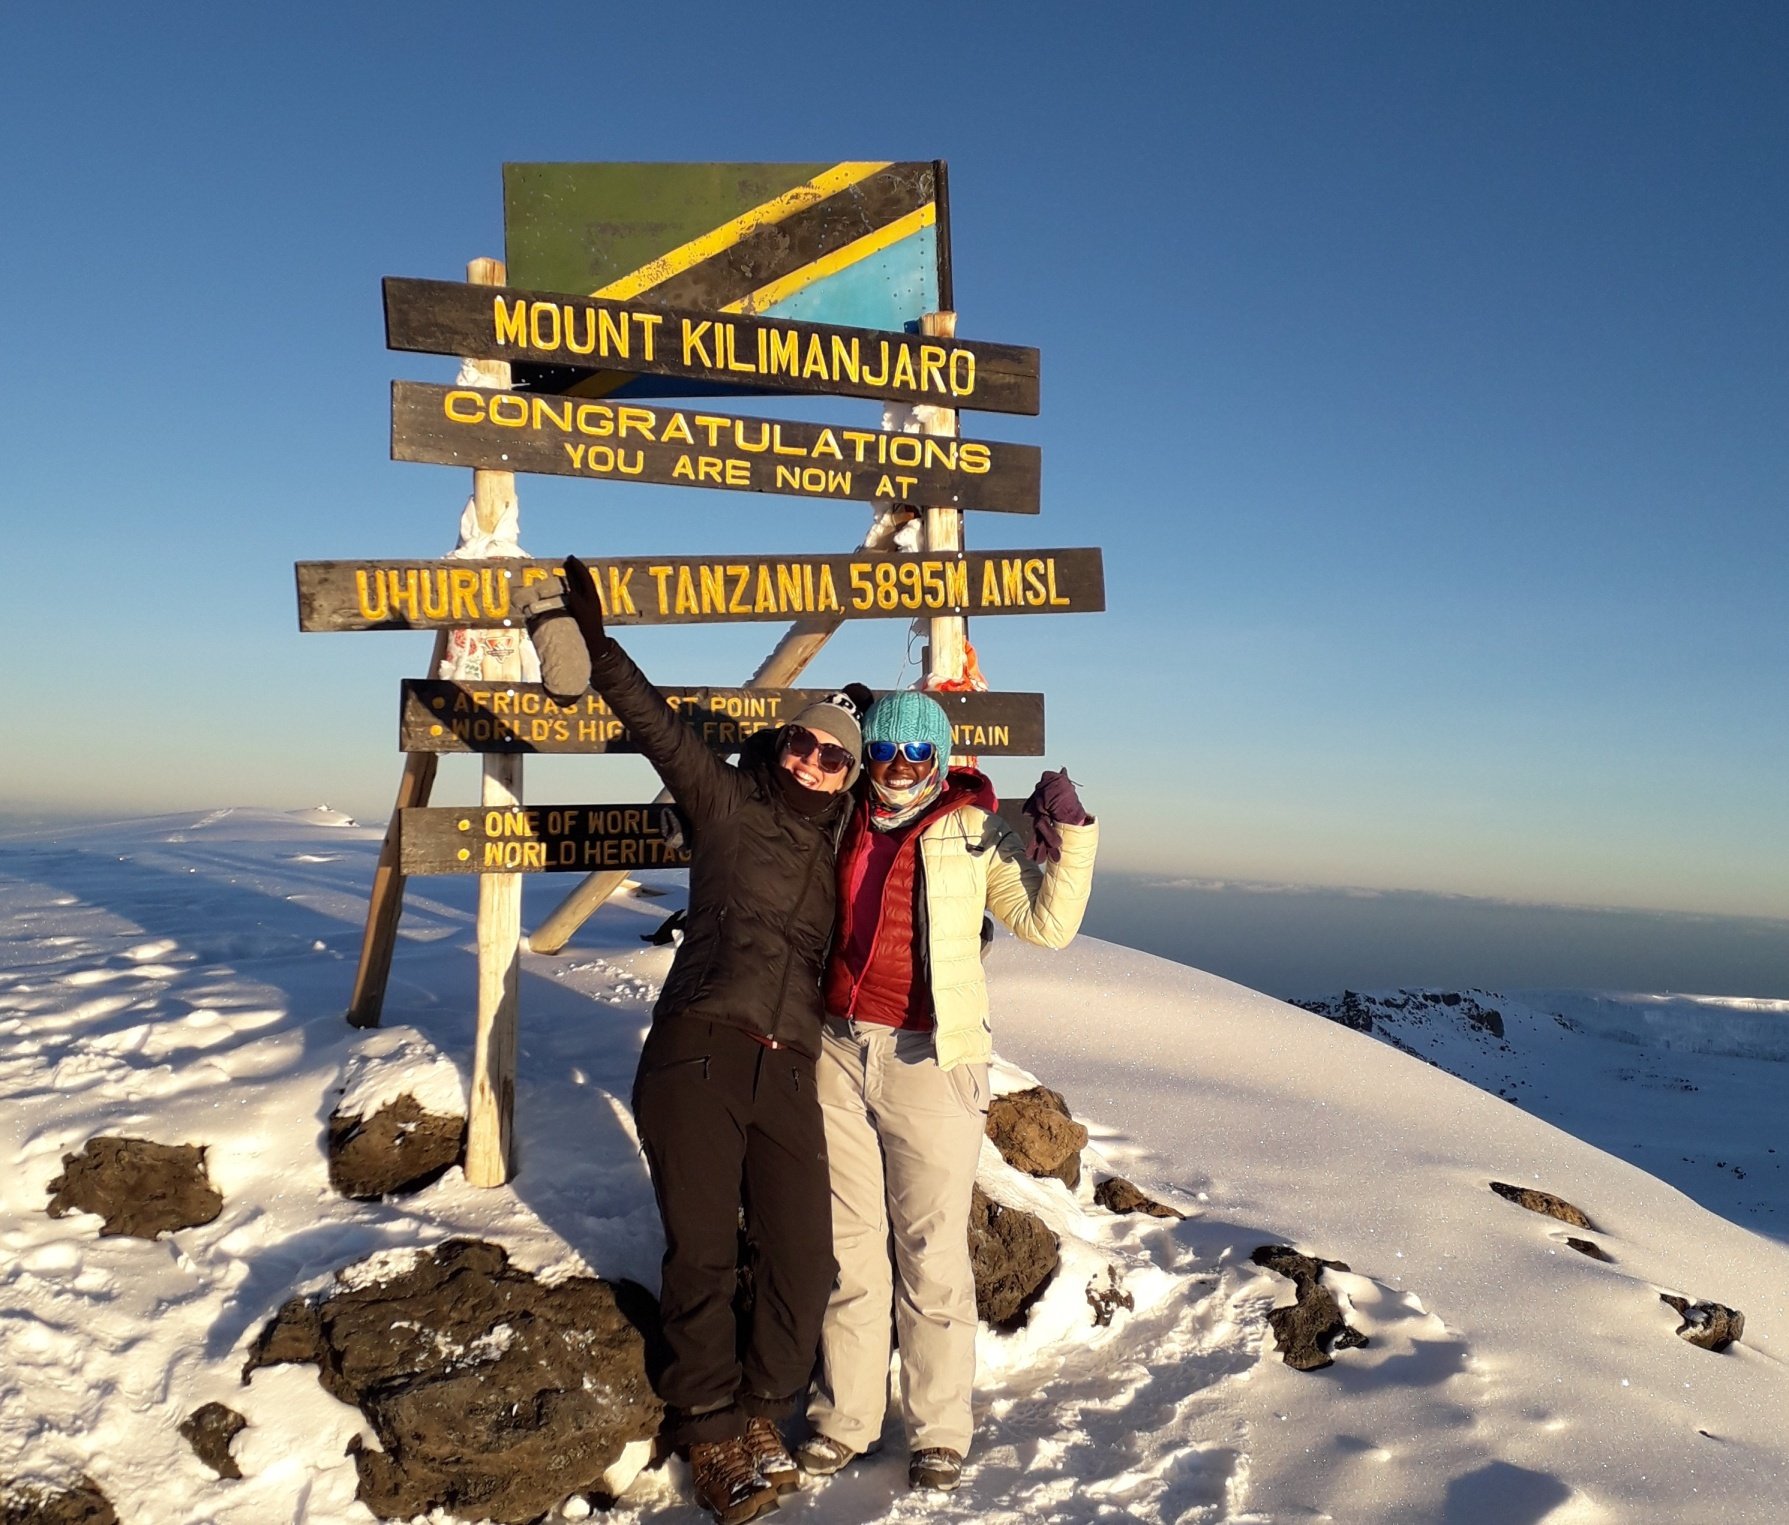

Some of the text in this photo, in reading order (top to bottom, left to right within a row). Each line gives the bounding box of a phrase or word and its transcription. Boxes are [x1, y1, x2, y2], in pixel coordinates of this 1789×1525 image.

[494, 294, 977, 396] MOUNT KILIMANJARO
[444, 390, 992, 474] CONGRATULATIONS
[564, 440, 919, 500] YOU ARE NOW AT
[355, 568, 510, 622] UHURU
[522, 566, 637, 616] PAK
[849, 560, 969, 610] 5895M
[982, 556, 1071, 608] AMSL
[710, 697, 782, 718] POINT
[452, 718, 570, 742] WORLD'S
[485, 811, 540, 838] ONE
[549, 810, 579, 836] OF
[484, 842, 577, 868] WORLD
